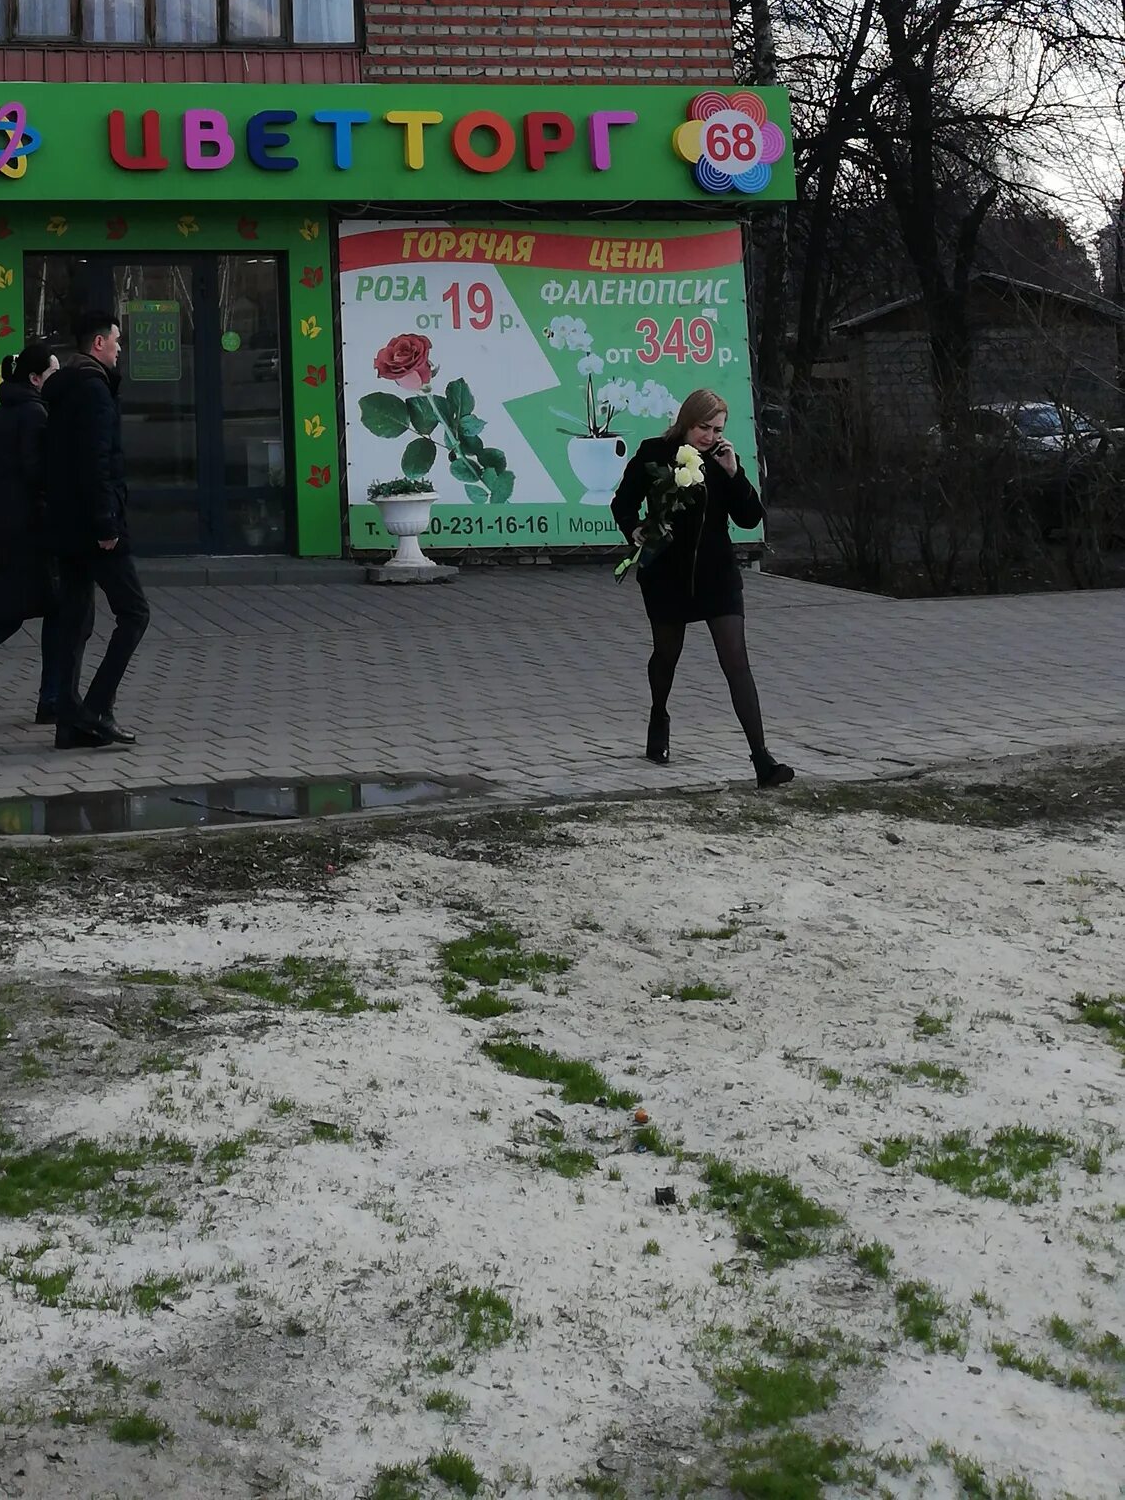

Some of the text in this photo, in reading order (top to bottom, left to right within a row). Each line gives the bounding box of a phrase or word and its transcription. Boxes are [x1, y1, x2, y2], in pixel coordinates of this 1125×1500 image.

[106, 108, 758, 173] ЦВЕТТОРГ 68
[400, 231, 664, 272] ГОРЯЧАЯ ЦЕНА
[355, 275, 428, 302] РОЗА
[416, 281, 522, 335] от 19 р.
[539, 278, 730, 306] ФАЛЕНОПСИС
[605, 317, 740, 368] от 349 р.
[568, 516, 620, 536] Морш
